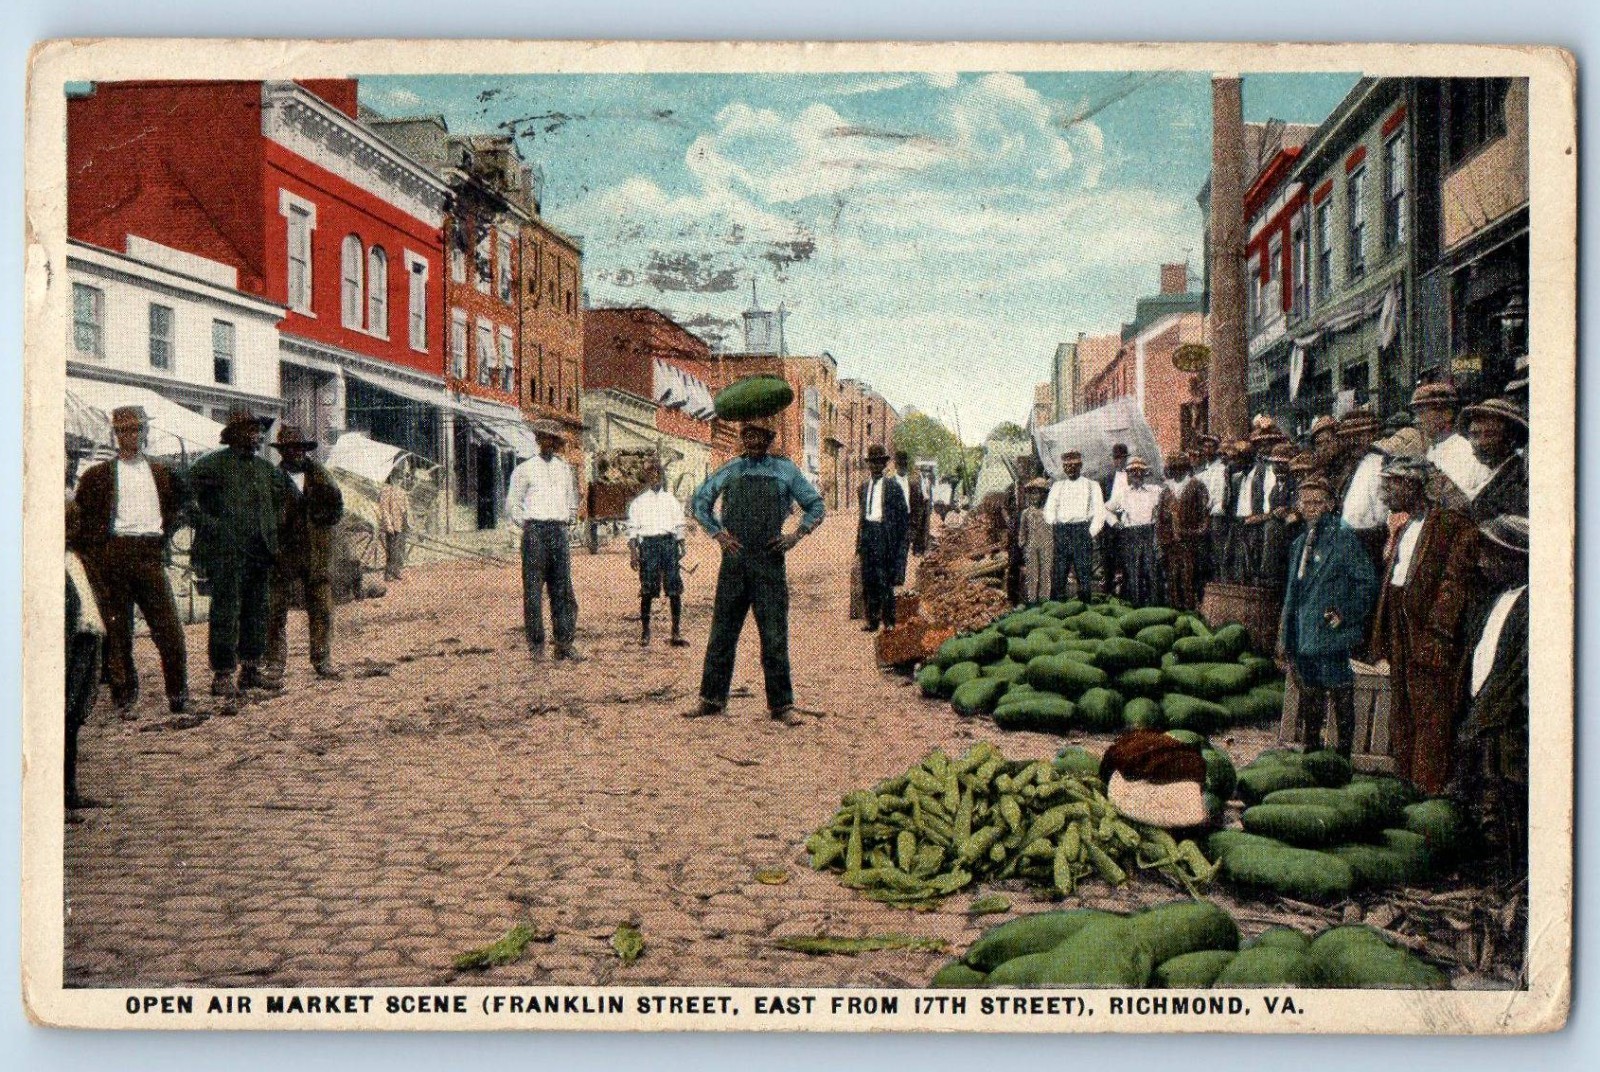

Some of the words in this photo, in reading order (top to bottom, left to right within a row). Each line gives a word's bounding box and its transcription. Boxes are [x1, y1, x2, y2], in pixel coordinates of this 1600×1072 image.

[126, 995, 192, 1014] OPEN
[208, 996, 251, 1014] AIR
[267, 996, 373, 1014] MARKET
[386, 996, 466, 1014] SCENE
[482, 996, 623, 1015] (FRANKLIN
[637, 996, 738, 1018] STREET,
[755, 997, 815, 1015] EAST
[832, 997, 897, 1015] FROM
[914, 997, 966, 1015] 17TH
[981, 997, 1094, 1018] STREET),
[1110, 997, 1250, 1018] RICHMOND,
[1264, 997, 1304, 1015] VA.
